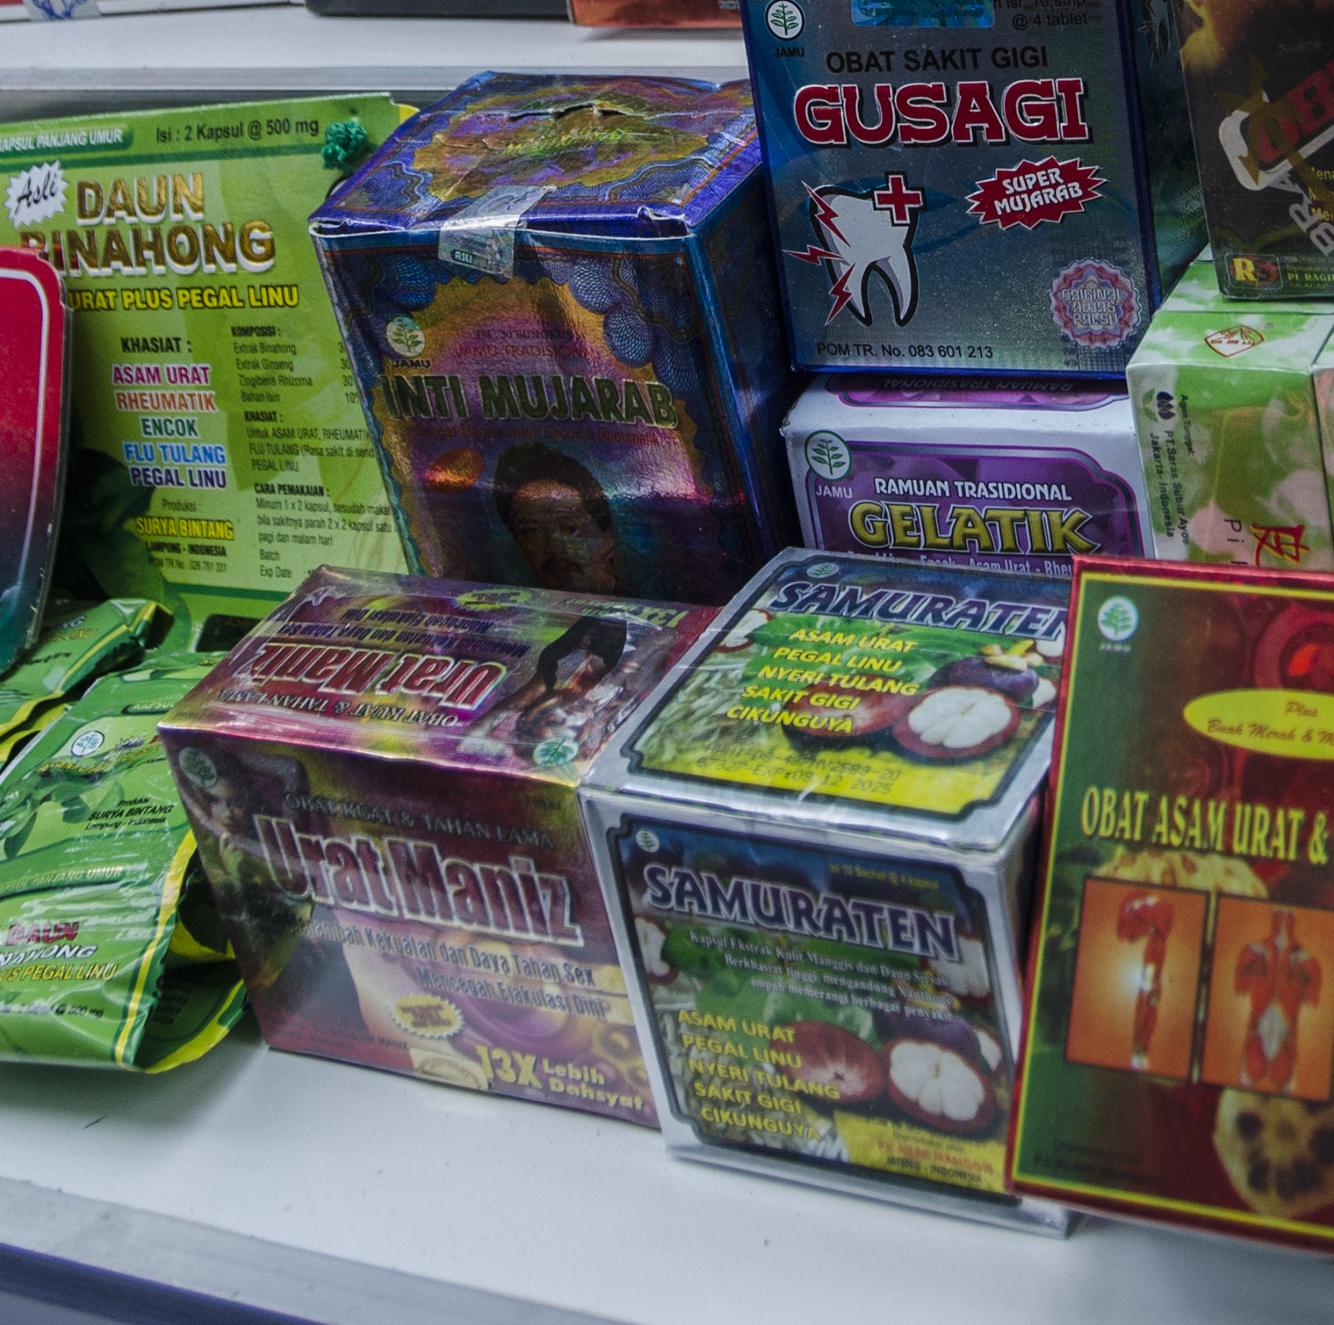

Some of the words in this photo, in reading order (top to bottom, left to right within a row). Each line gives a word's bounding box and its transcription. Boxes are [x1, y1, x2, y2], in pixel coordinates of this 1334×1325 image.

[774, 45, 806, 67] JAMU
[825, 49, 896, 75] OBAT
[903, 47, 984, 73] SAKIT
[990, 45, 1050, 69] GIGI
[792, 78, 1094, 148] GUSAGI
[36, 132, 89, 151] PANJANG
[89, 128, 124, 147] UMUR
[14, 173, 61, 214] Asli
[75, 172, 207, 225] DAUN
[993, 181, 1085, 217] MUJARAB
[391, 357, 431, 370] JAMU
[816, 342, 851, 358] POM
[851, 343, 879, 358] TR.
[881, 344, 906, 359] No.
[908, 343, 937, 359] 083
[937, 344, 967, 359] 601
[967, 344, 995, 359] 213
[111, 364, 163, 387] ASAM
[163, 364, 212, 387] URAT
[378, 373, 466, 421] INTI
[478, 375, 681, 429] MUJARAB
[140, 416, 200, 440] ENCOK
[122, 443, 158, 465] FLU
[160, 443, 228, 467] TULANG
[161, 499, 197, 513] Produksi
[815, 484, 854, 500] JAMU
[874, 476, 951, 499] RAMUAN
[953, 478, 1073, 502] TRASIDIONAL
[135, 519, 178, 540] SURYA
[178, 521, 236, 542] BINTANG
[847, 498, 1104, 556] GELATIK
[788, 625, 861, 649] ASAM
[858, 632, 920, 655] URAT
[247, 641, 379, 696] Maniz
[379, 650, 510, 712] Urat
[1078, 784, 1150, 842] OBAT
[1151, 791, 1228, 853] ASAM
[1230, 801, 1307, 863] URAT
[1306, 809, 1330, 866] &
[252, 811, 397, 920] Urat
[387, 832, 586, 949] Maniz
[642, 863, 965, 965] SAMURATEN
[13, 962, 70, 983] PEGAL
[70, 962, 120, 982] LINU
[363, 924, 438, 963] Kekuatan
[437, 931, 465, 961] dan
[466, 943, 511, 976] Daya
[512, 949, 562, 985] Tahan
[563, 962, 596, 990] Sex
[677, 1008, 740, 1033] ASAM
[740, 1019, 797, 1045] URAT
[475, 1042, 543, 1090] 13X
[680, 1032, 752, 1062] PEGAL
[752, 1045, 804, 1071] LINU
[541, 1057, 606, 1086] Lebih
[687, 1057, 750, 1083] NYERI
[752, 1068, 842, 1101] TULANG
[548, 1077, 646, 1110] Dahsyat
[693, 1080, 755, 1106] SAKIT
[756, 1091, 803, 1115] GIGI
[699, 1104, 823, 1142] CIKUNGUYA
